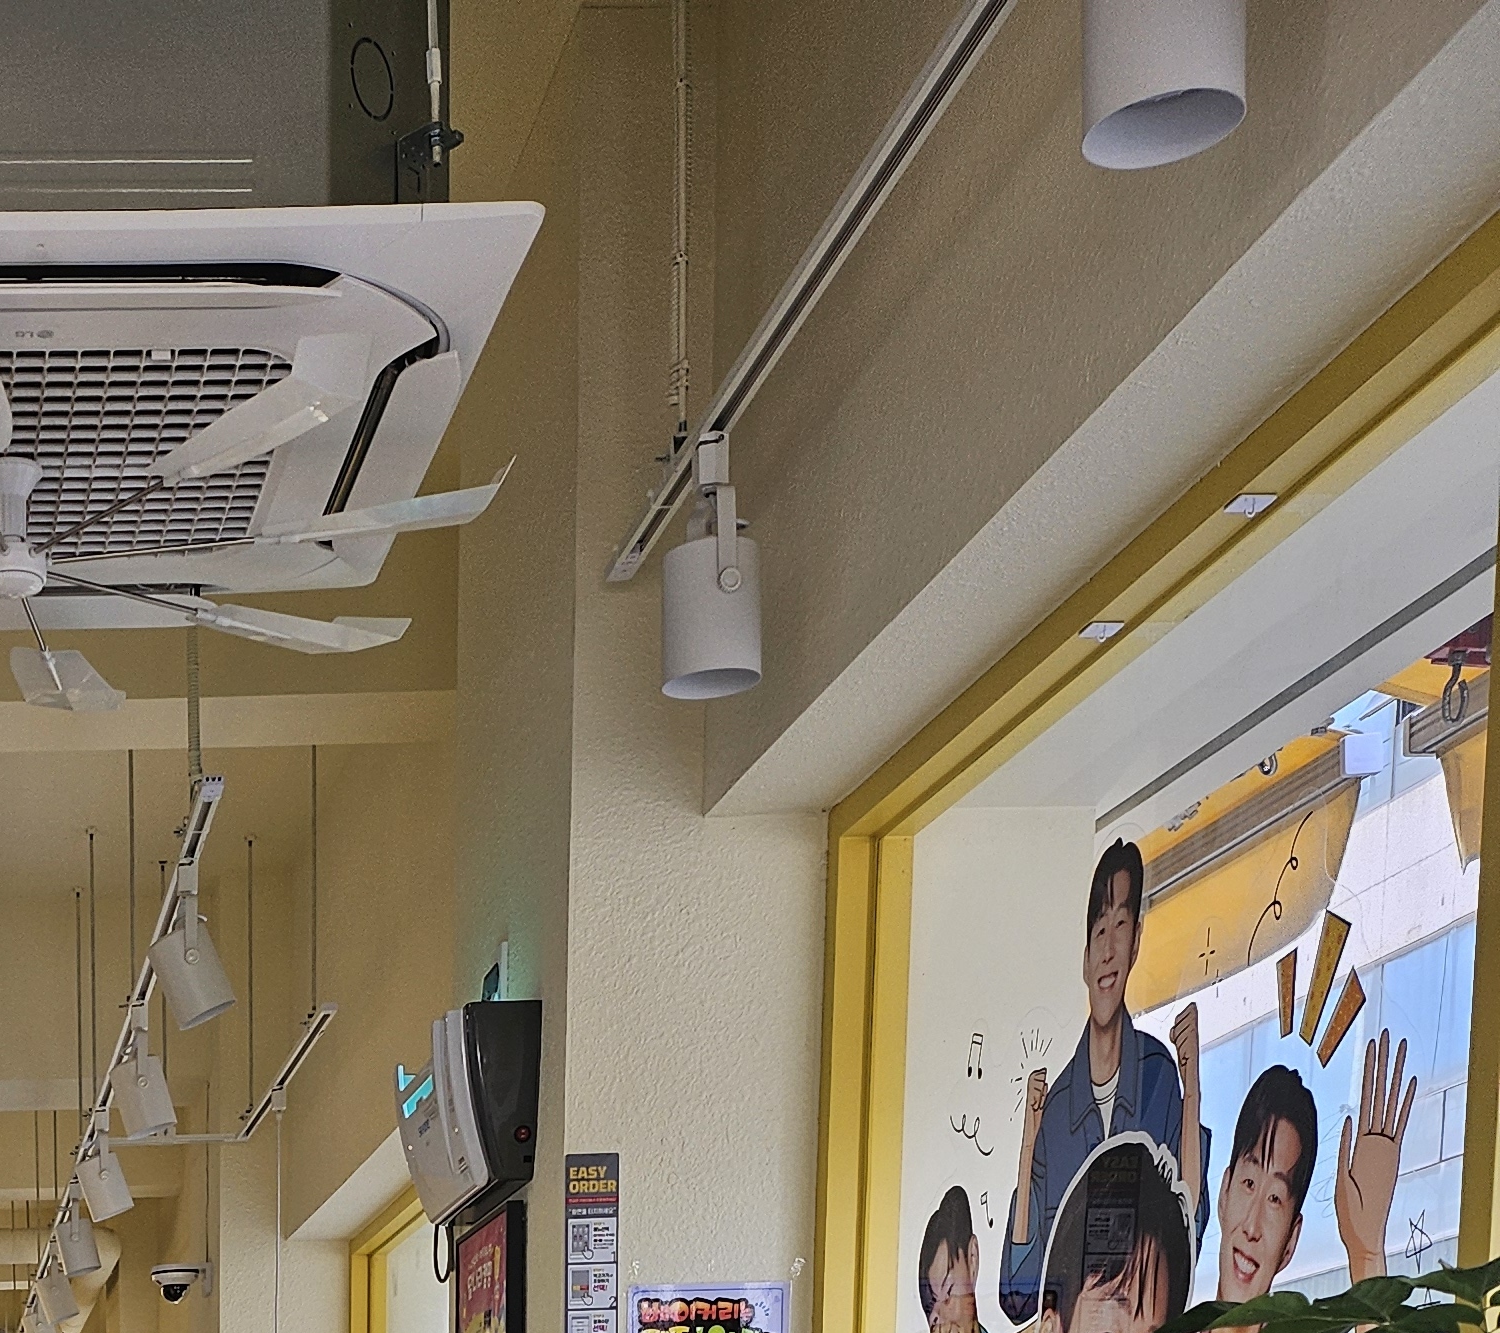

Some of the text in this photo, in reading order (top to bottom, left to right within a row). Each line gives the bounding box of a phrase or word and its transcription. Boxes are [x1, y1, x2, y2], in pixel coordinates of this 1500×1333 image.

[569, 1165, 608, 1179] EASY
[569, 1179, 617, 1194] ORDER
[609, 1296, 617, 1307] 2
[639, 1300, 754, 1325] 베이커리는
